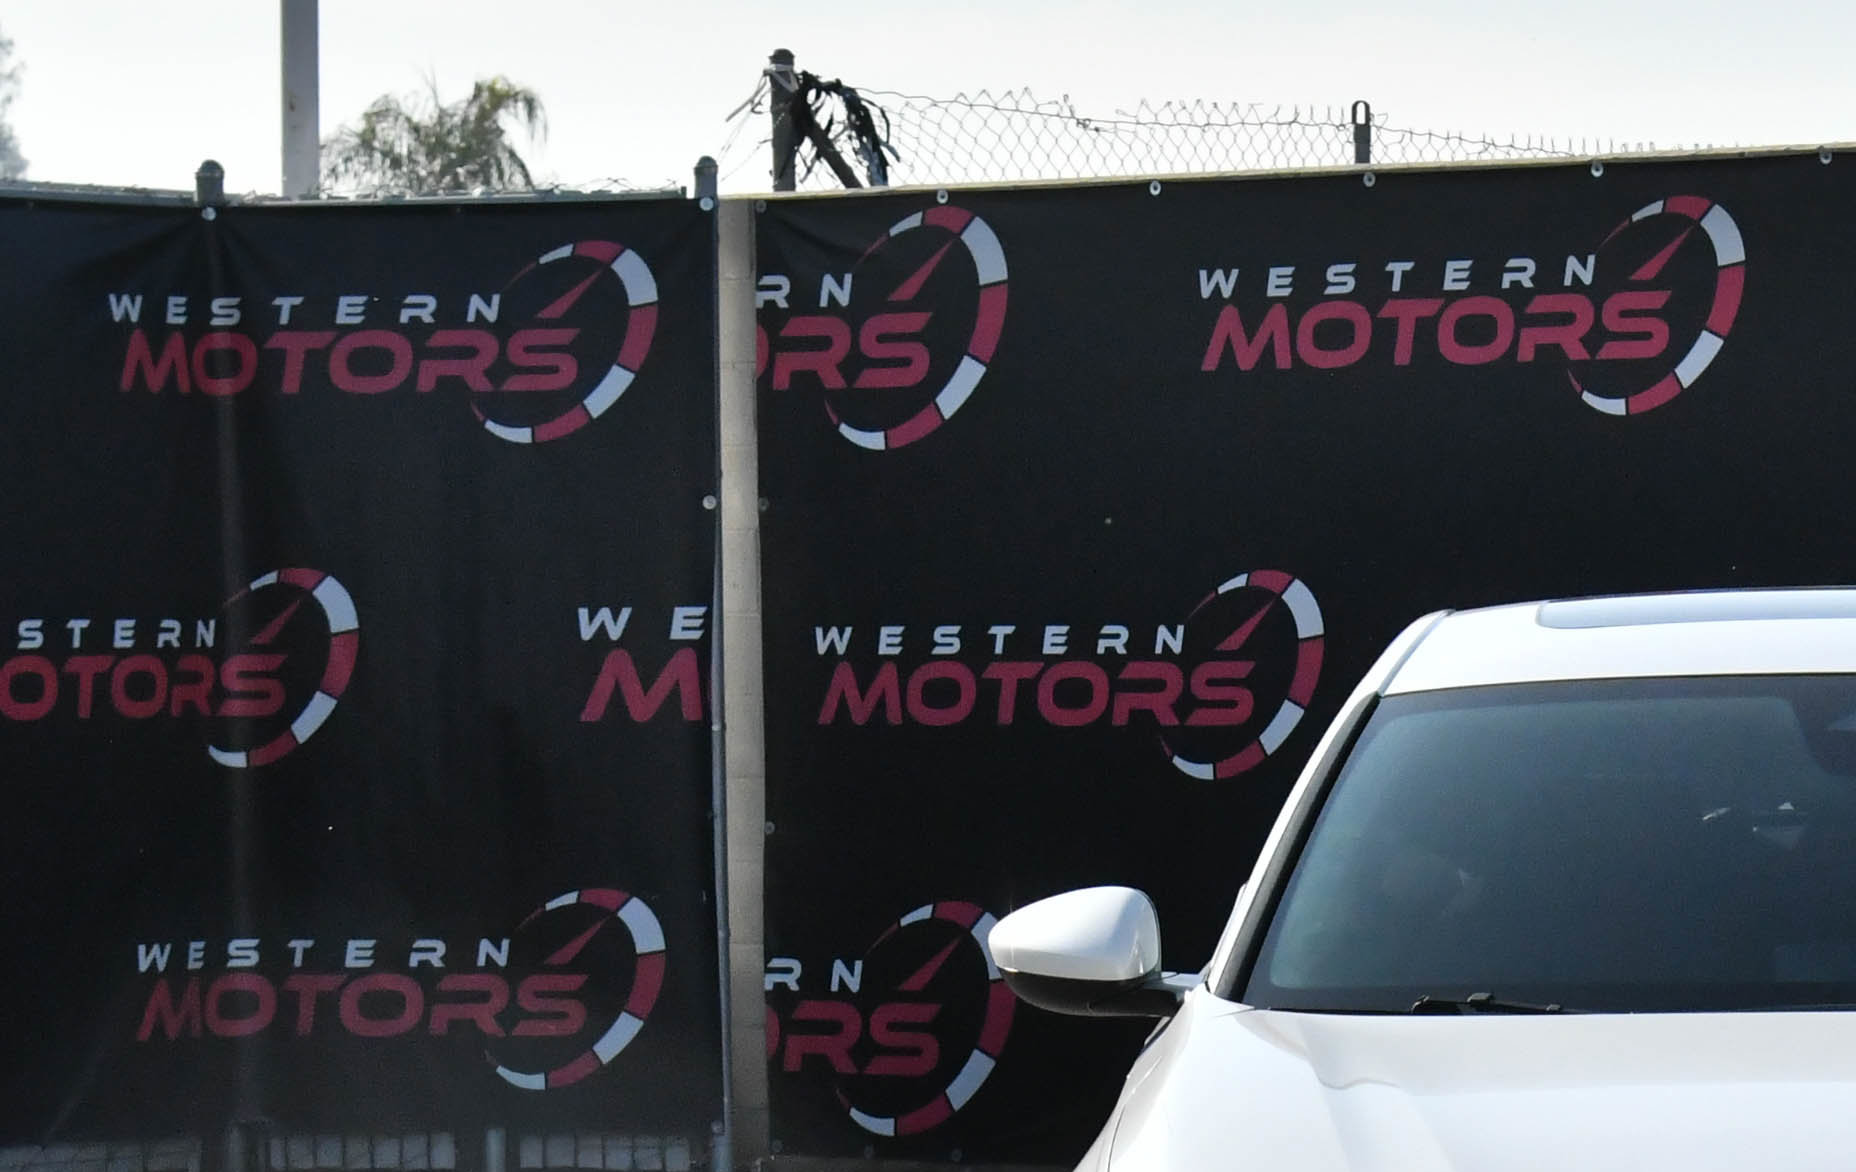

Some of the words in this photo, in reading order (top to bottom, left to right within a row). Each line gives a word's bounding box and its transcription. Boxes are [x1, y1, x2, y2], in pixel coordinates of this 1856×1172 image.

[1199, 255, 1595, 299] WESTERN
[109, 294, 500, 325] WESTERN
[1203, 291, 1670, 370] MOTORS
[121, 328, 580, 395] MOTORS
[18, 619, 215, 649] STERN
[578, 606, 707, 641] WE
[815, 625, 1183, 655] WESTERN
[818, 661, 1254, 726] MOTORS
[138, 939, 510, 972] WESTERN
[137, 973, 589, 1041] MOTORS
